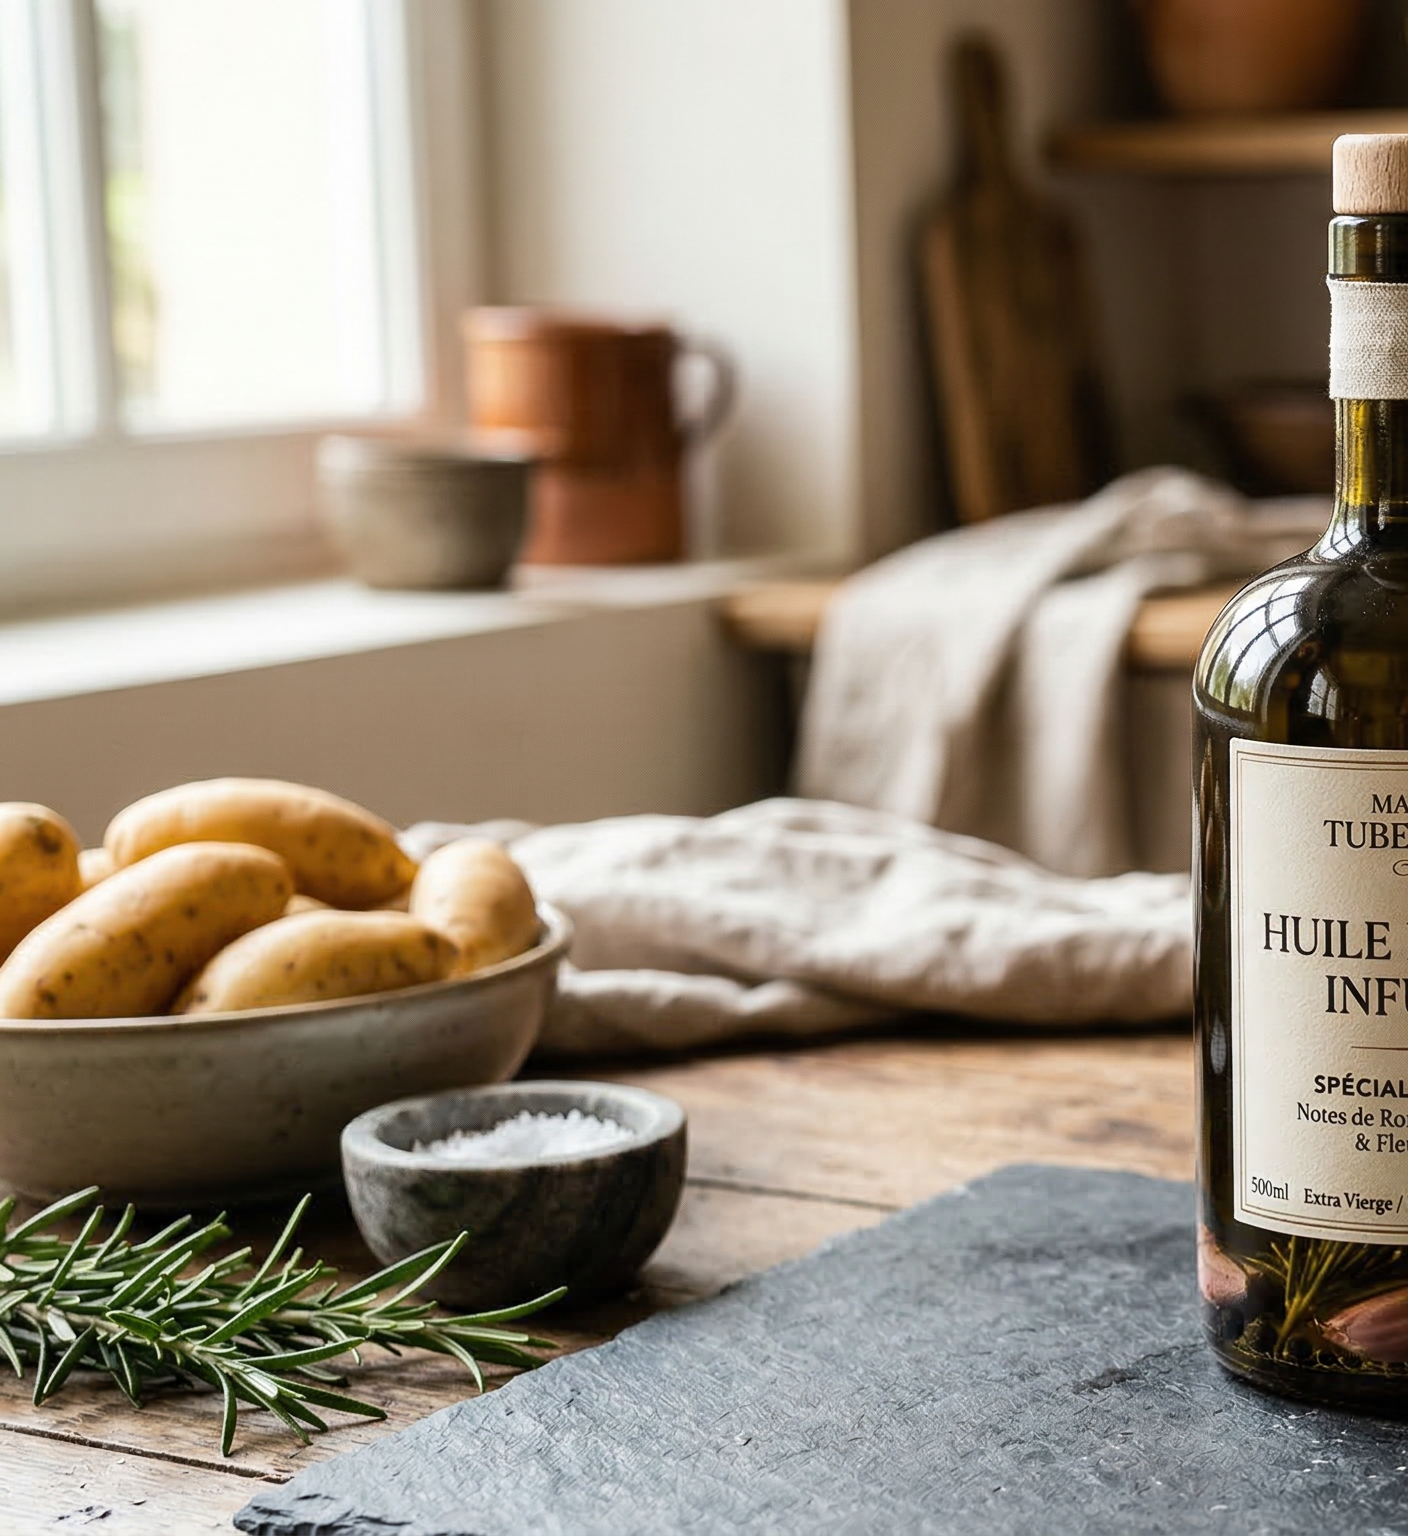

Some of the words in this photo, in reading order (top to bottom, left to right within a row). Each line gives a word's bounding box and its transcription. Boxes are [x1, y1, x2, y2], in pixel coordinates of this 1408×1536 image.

[1263, 912, 1392, 960] HUILE
[1297, 1102, 1347, 1125] Notes
[1351, 1107, 1375, 1127] de
[1355, 1133, 1371, 1151] &
[1251, 1176, 1289, 1200] 500ml
[1303, 1188, 1341, 1208] Extra
[1344, 1192, 1393, 1215] Vierge
[1396, 1195, 1403, 1213] /
